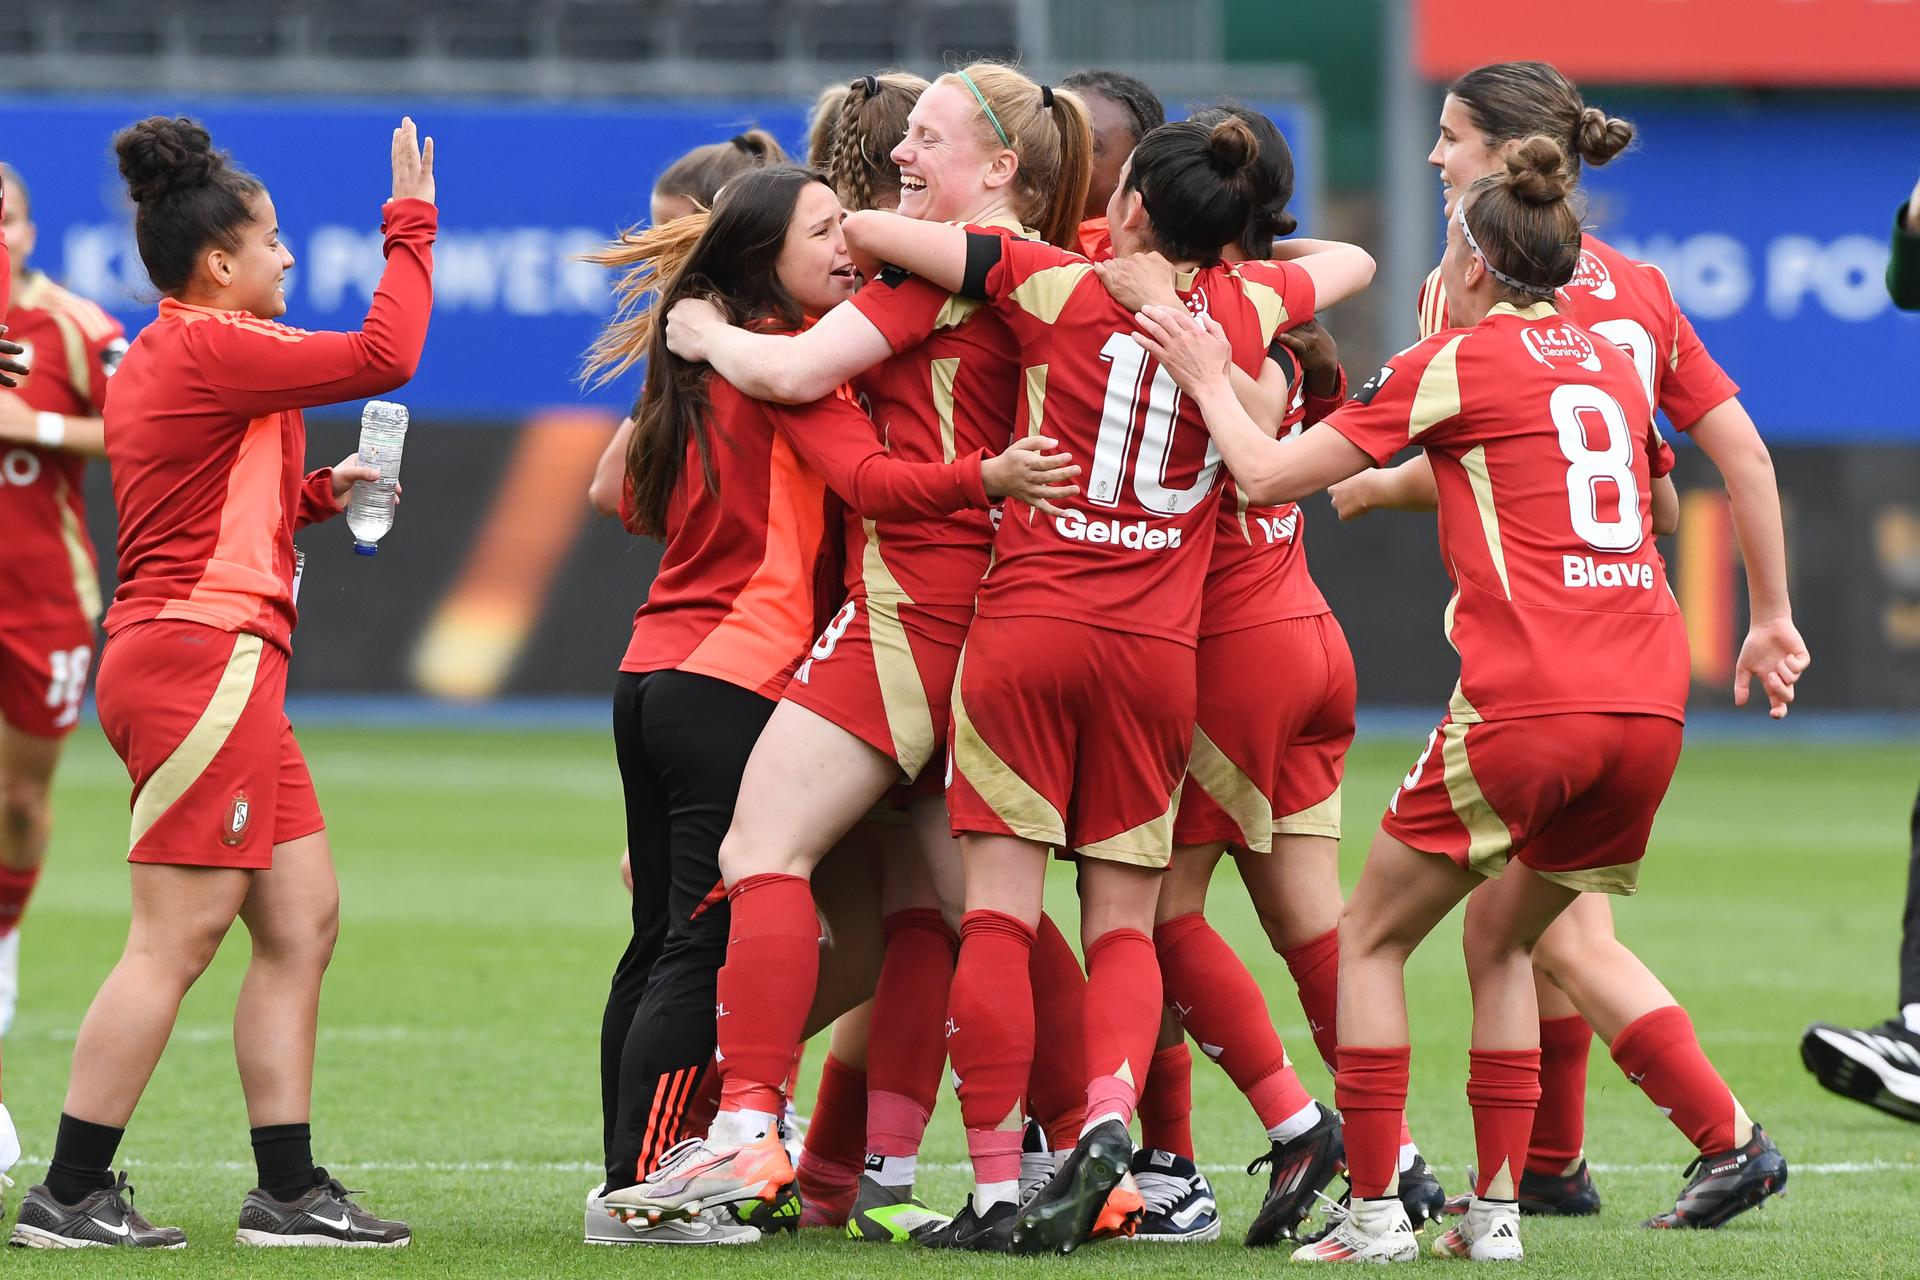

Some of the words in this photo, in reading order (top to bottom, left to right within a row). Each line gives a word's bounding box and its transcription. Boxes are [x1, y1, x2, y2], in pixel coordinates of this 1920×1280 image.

[1765, 234, 1892, 322] PO
[1541, 346, 1582, 359] Cleaning
[1087, 331, 1224, 518] 10
[1550, 384, 1643, 553] 8
[1563, 554, 1654, 590] Blave
